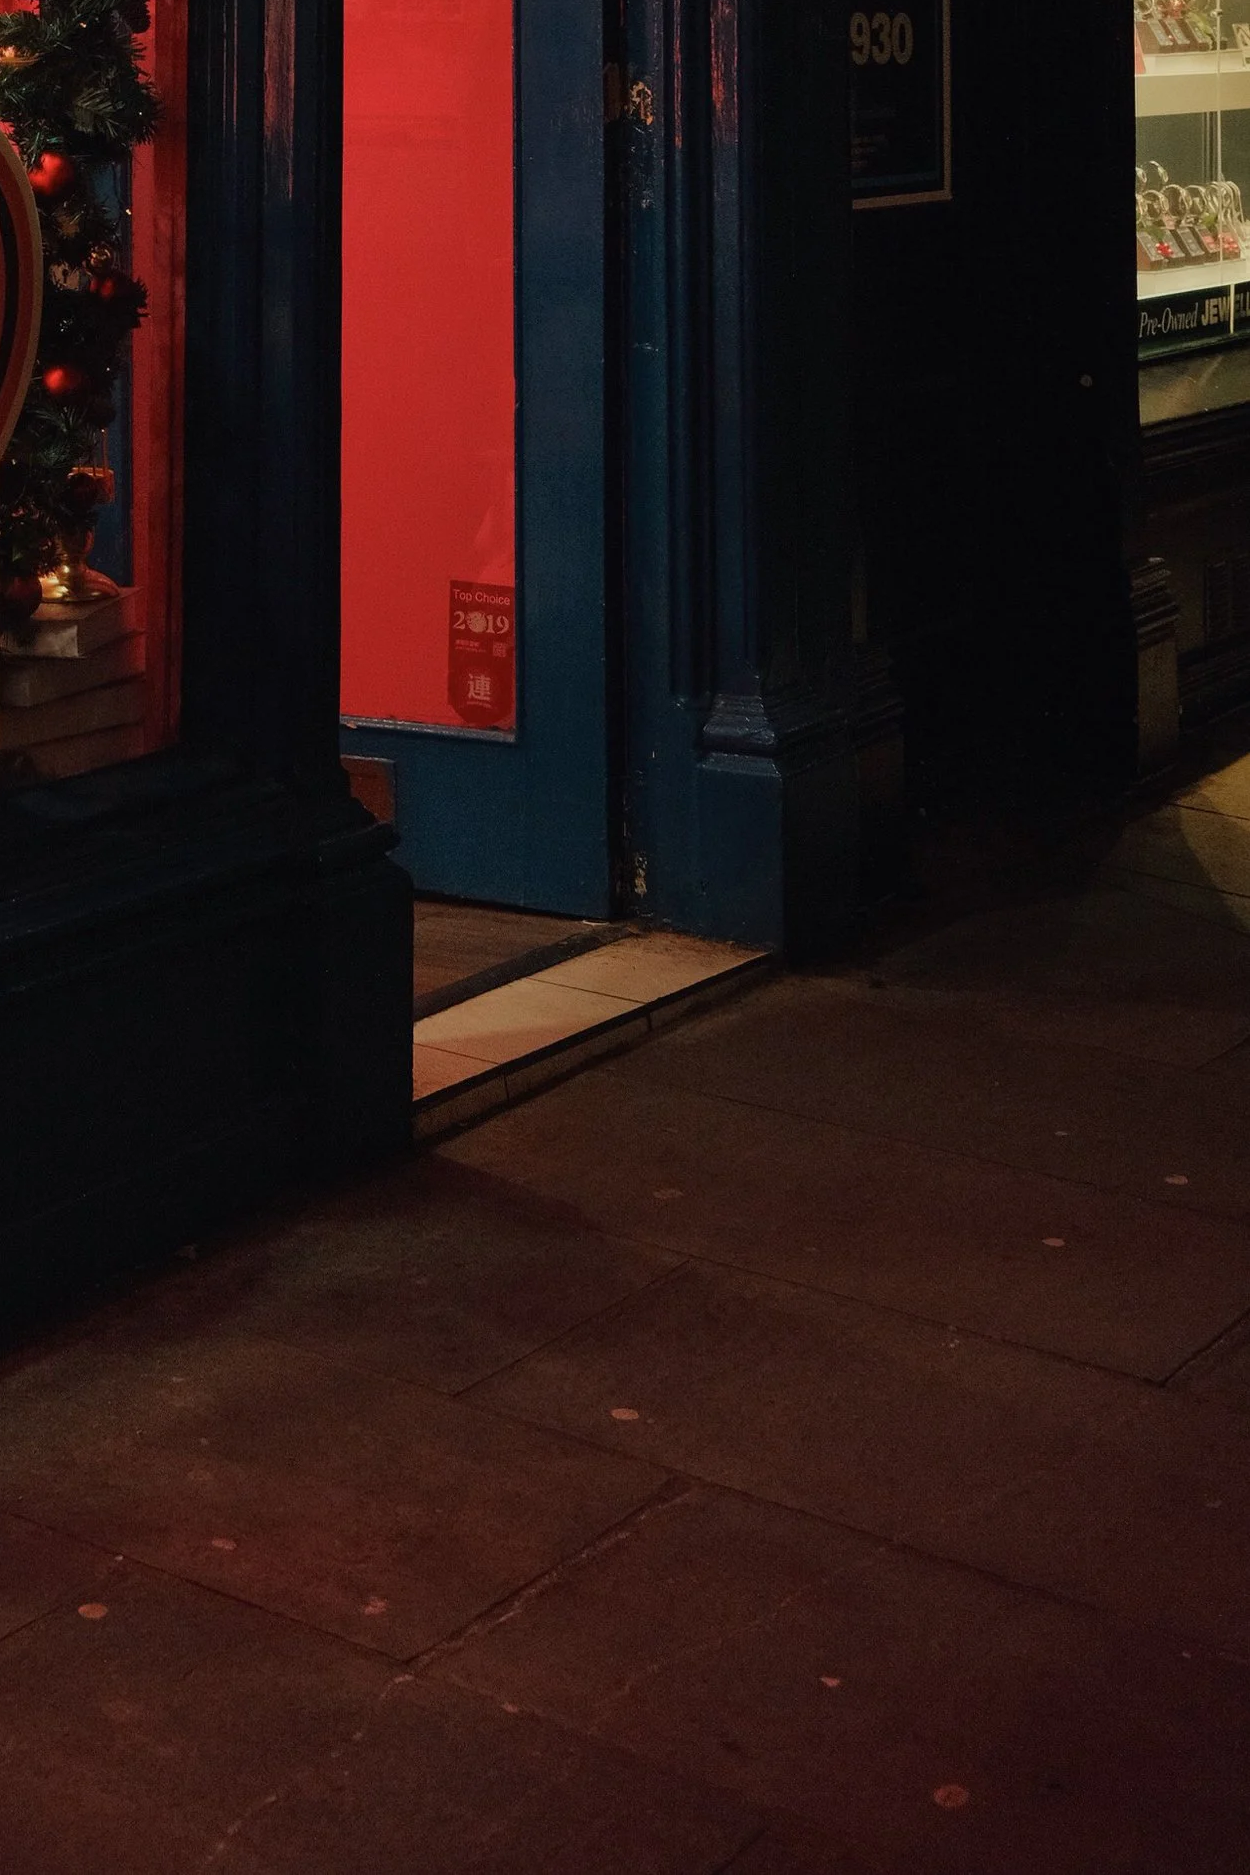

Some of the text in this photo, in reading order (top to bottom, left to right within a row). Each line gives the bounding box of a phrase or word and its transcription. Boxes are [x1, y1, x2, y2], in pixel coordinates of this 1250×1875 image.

[1138, 301, 1199, 338] Pre-Owned
[453, 588, 511, 606] Top Choice
